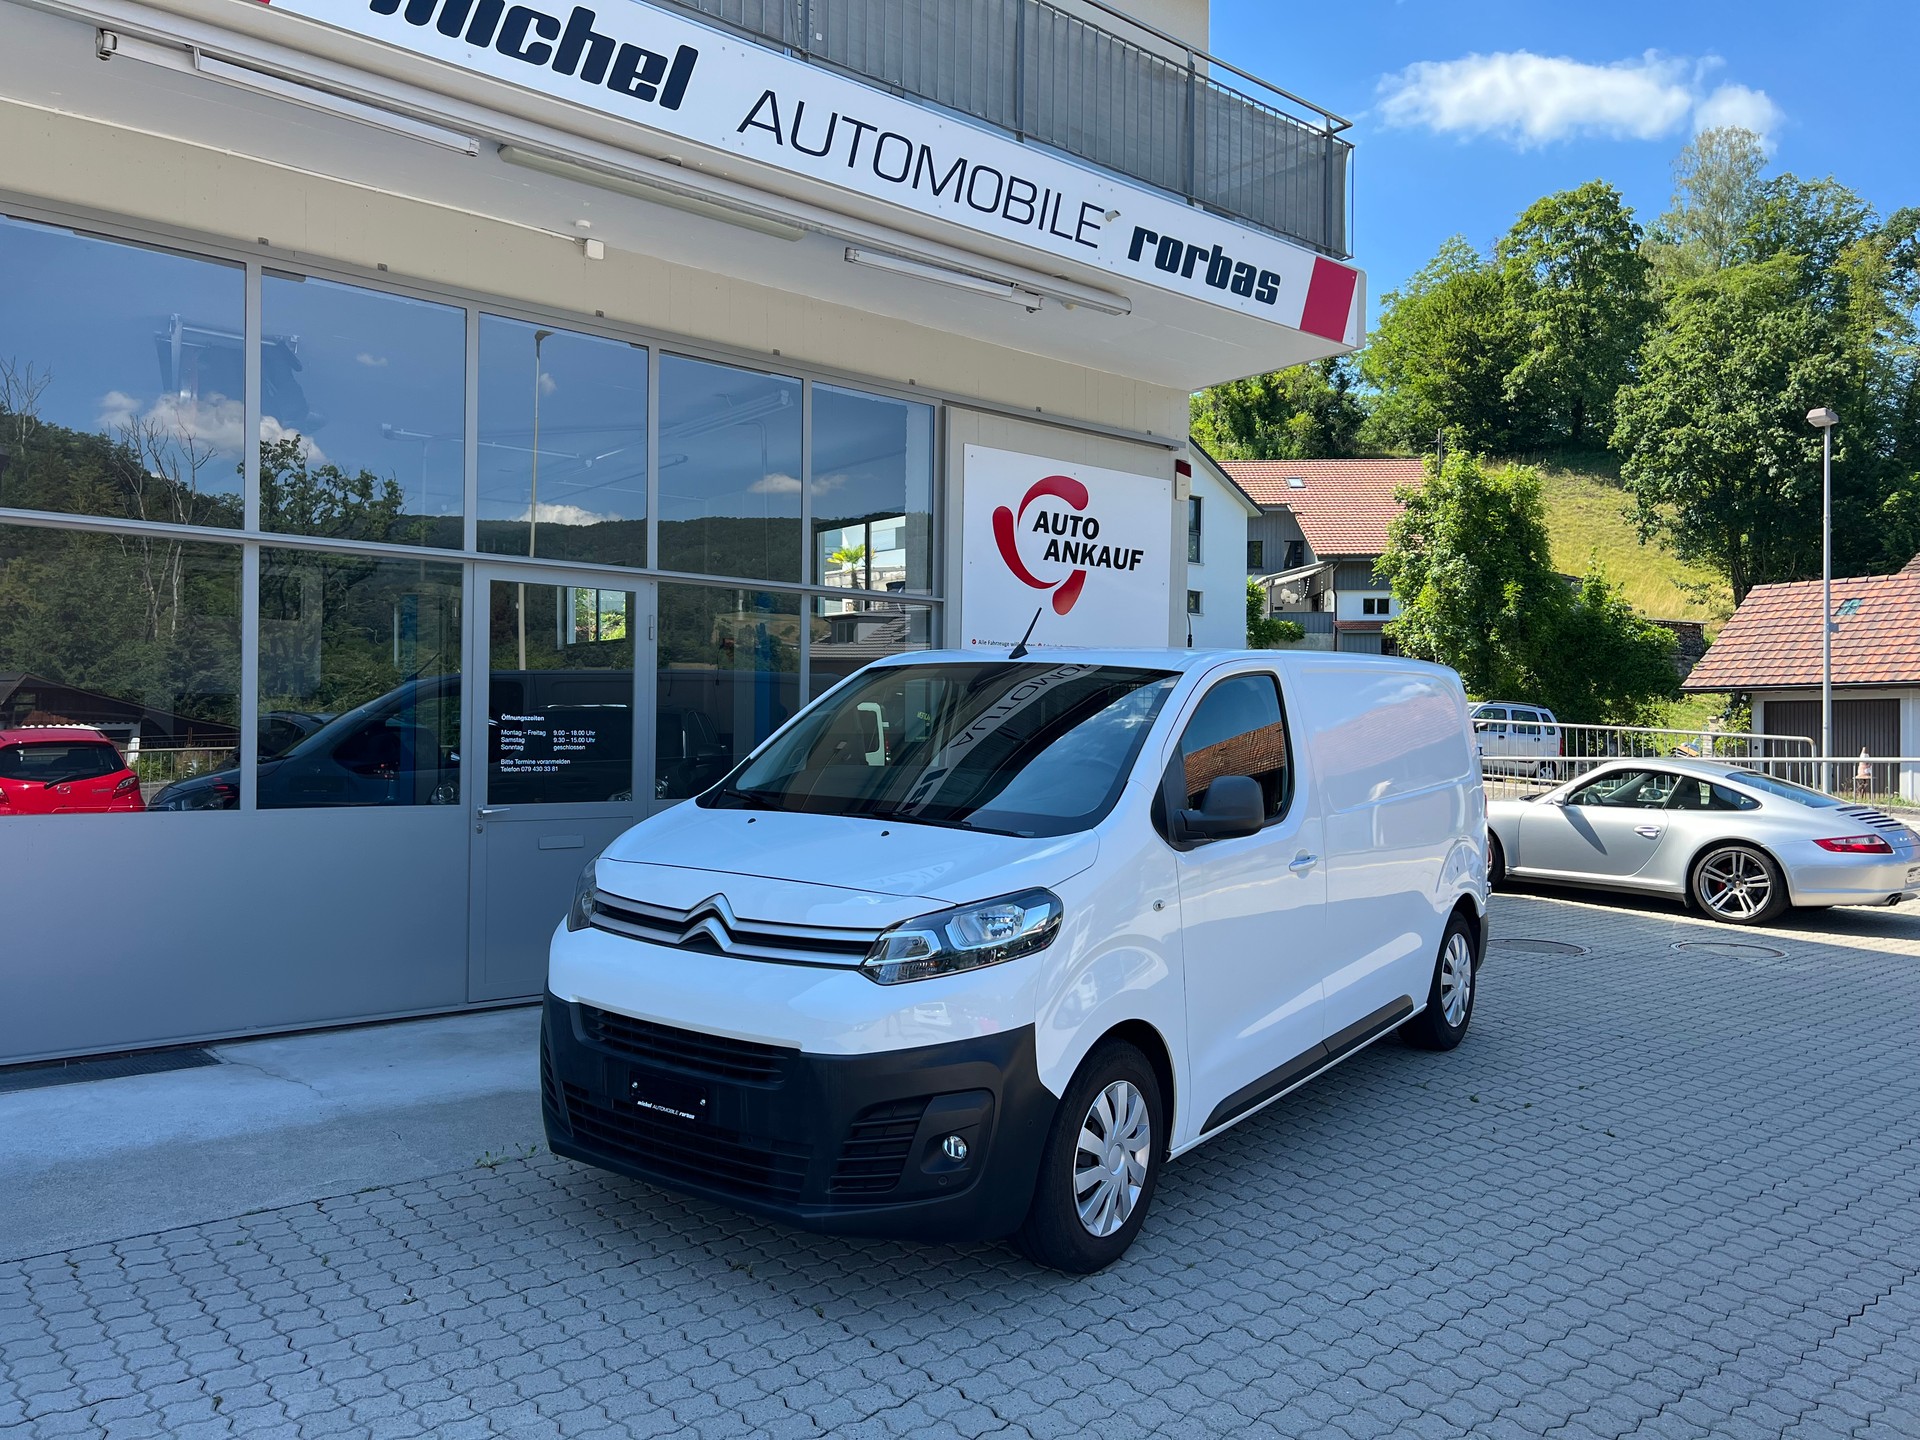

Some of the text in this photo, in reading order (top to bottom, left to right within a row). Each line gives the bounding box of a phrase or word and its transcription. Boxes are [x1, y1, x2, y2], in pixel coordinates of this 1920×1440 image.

[736, 89, 1105, 249] AUTOMOBILE
[1127, 225, 1281, 306] rorbas
[1032, 511, 1100, 540] AUTO
[1043, 539, 1144, 571] ANKAUF
[652, 1104, 679, 1116] AUTOMOBILE
